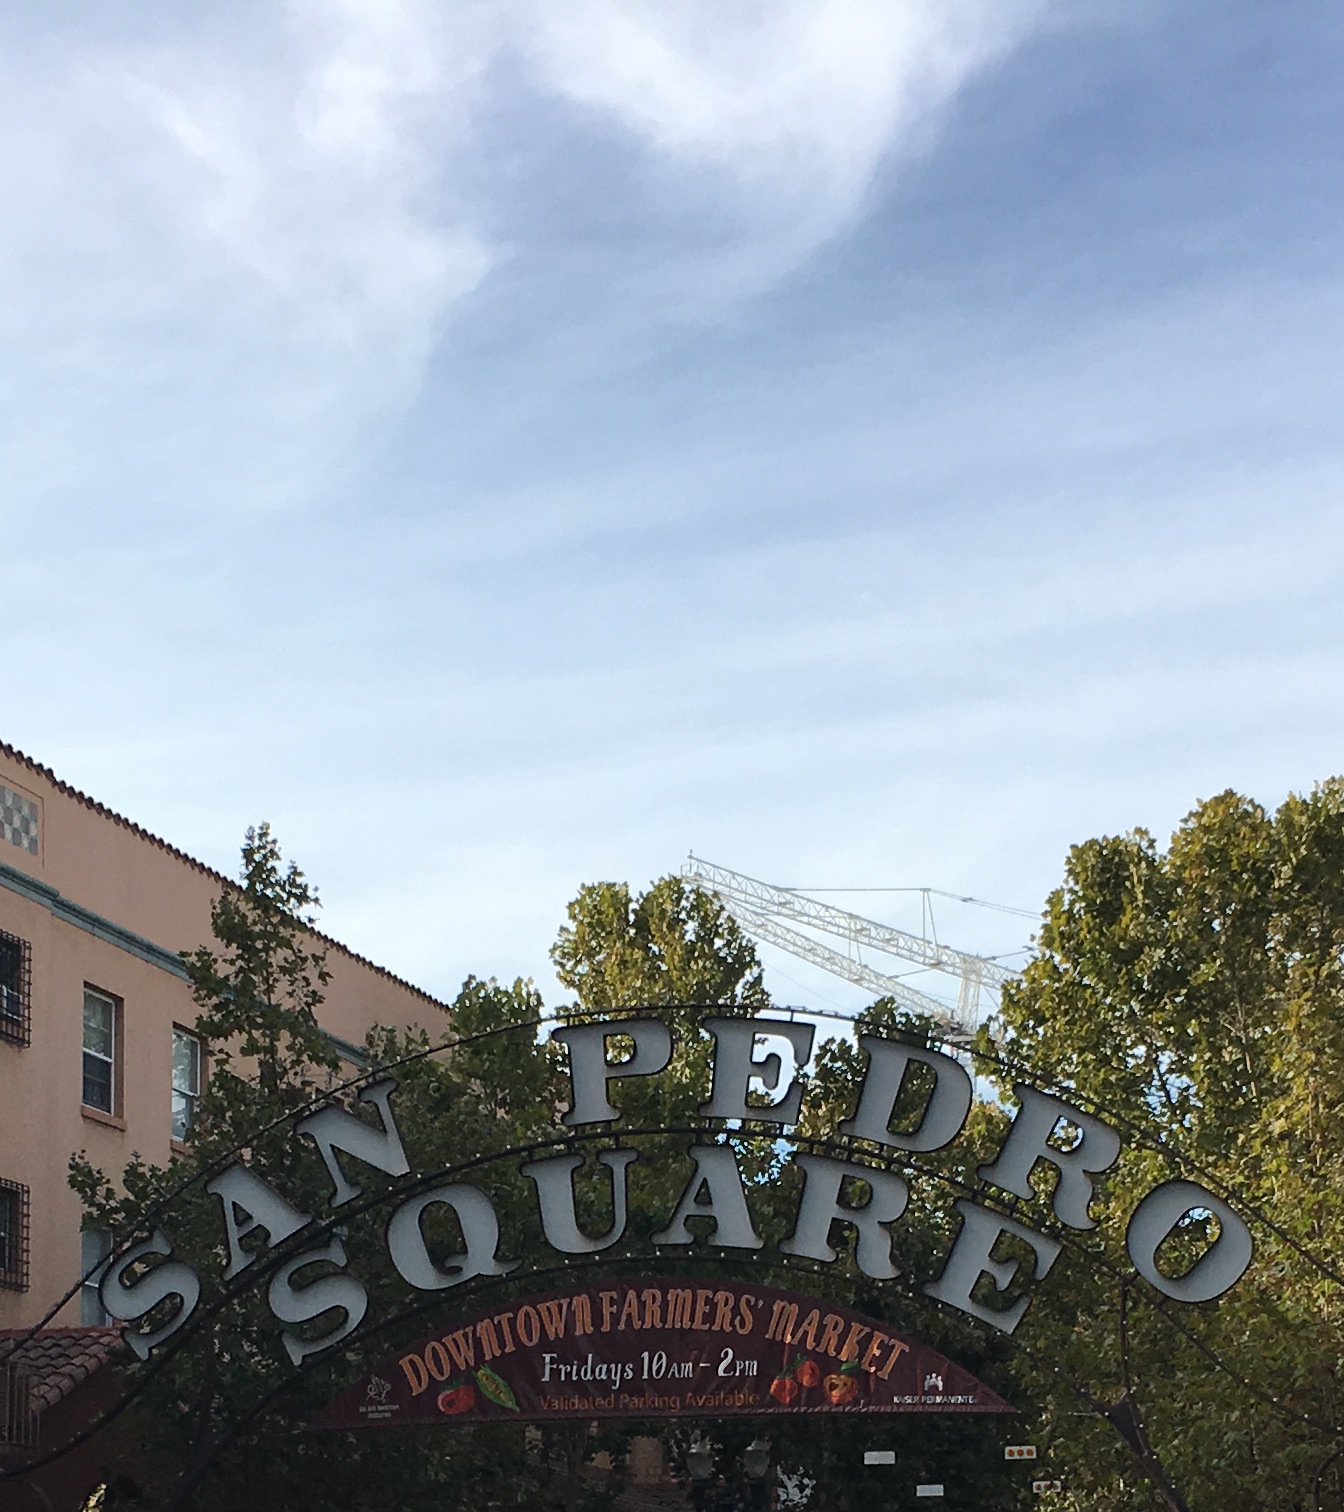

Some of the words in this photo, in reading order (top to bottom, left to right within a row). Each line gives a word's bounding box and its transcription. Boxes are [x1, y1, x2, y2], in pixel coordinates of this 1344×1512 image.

[98, 1076, 411, 1362] SAN
[552, 1016, 1254, 1303] PEDRO
[268, 1144, 1064, 1367] SQUARE
[398, 1293, 594, 1397] DOWNTOWN
[599, 1287, 764, 1335] FARMERS'
[764, 1299, 909, 1381] MARKET
[541, 1352, 634, 1390] Fridays
[540, 1393, 615, 1411] Validated
[618, 1393, 680, 1413] Parking
[685, 1391, 760, 1409] Available
